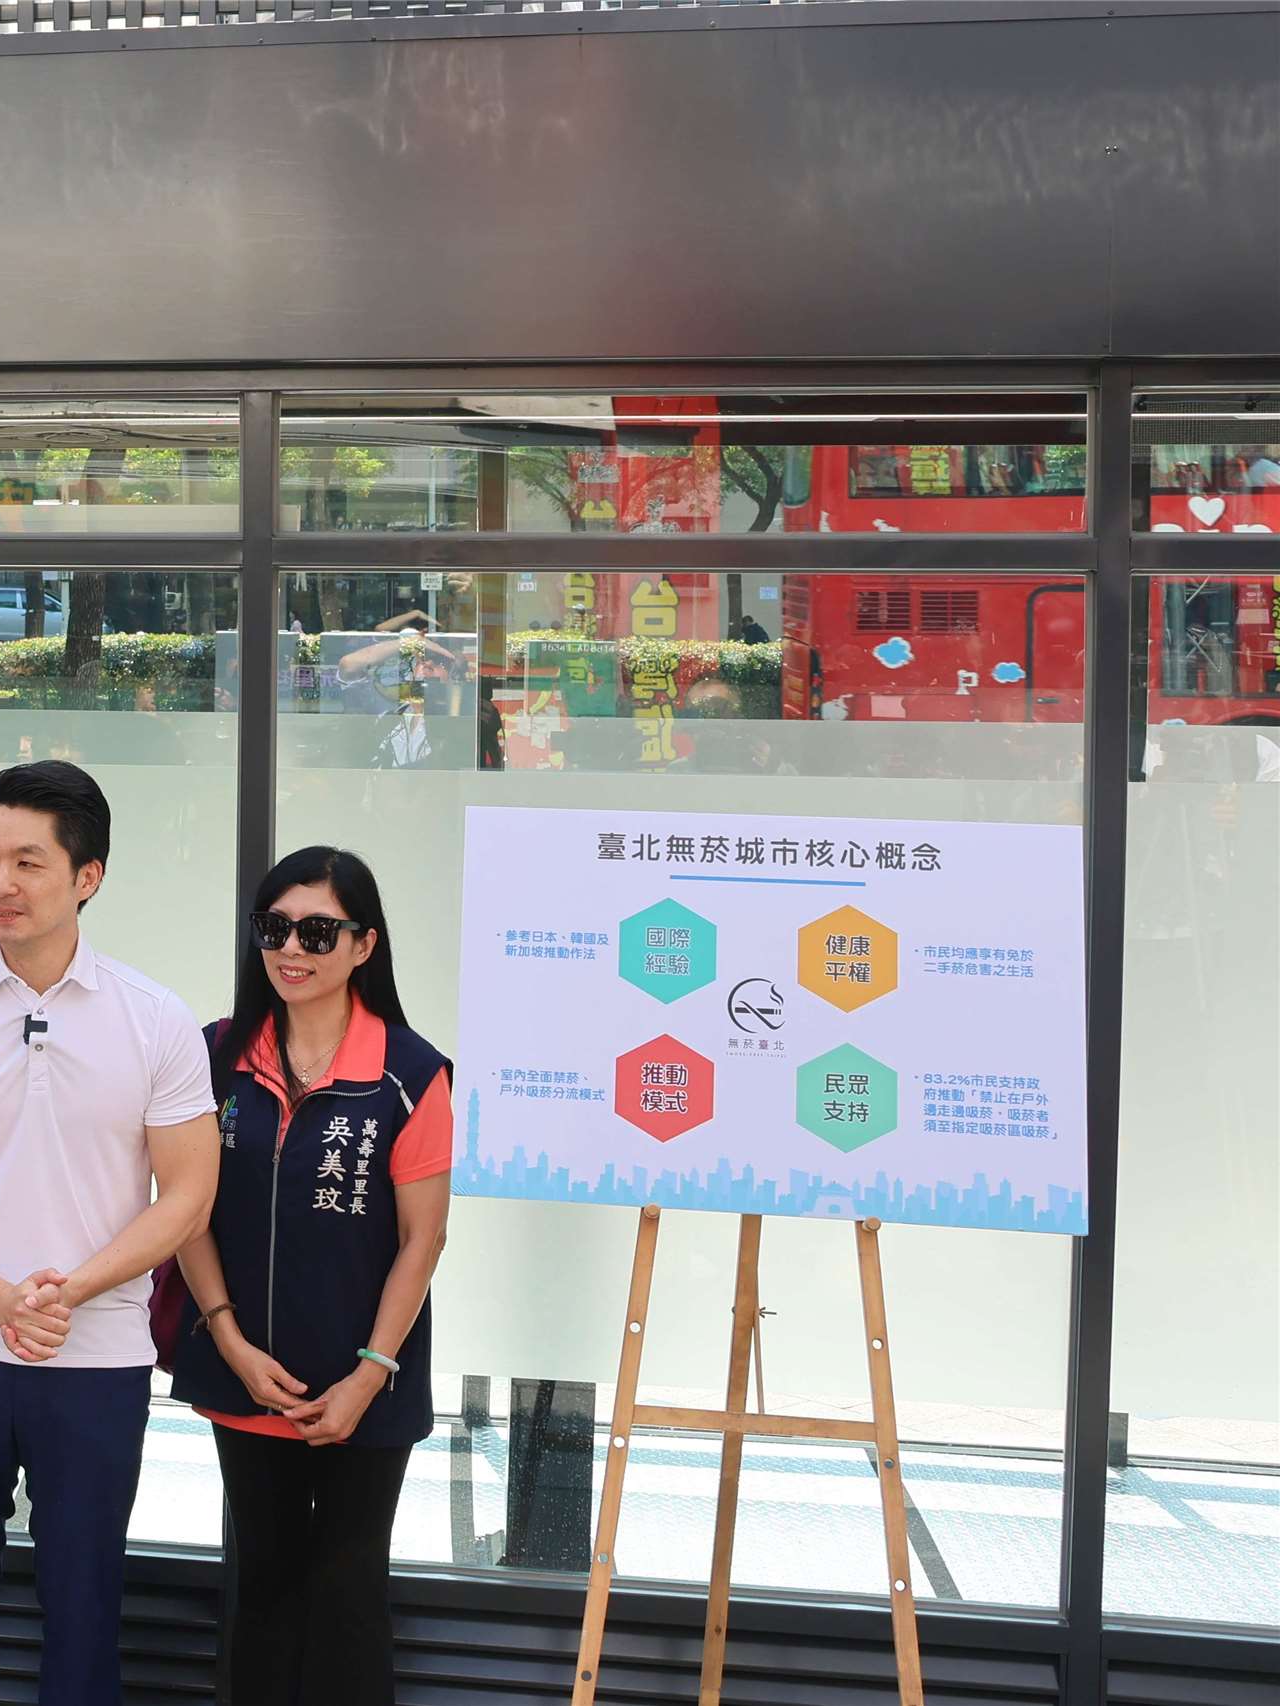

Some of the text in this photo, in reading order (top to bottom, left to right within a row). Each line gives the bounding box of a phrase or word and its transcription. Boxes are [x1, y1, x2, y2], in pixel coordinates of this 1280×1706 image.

[596, 832, 942, 871] 臺北無菸城市核心概念
[645, 927, 690, 949] 國際
[825, 934, 871, 956] 健康
[504, 944, 596, 960] 新加坡推動作法
[645, 953, 689, 976] 經驗
[825, 962, 871, 983] 平權
[642, 1062, 687, 1086] 推動
[824, 1073, 870, 1095] 民眾
[499, 1083, 606, 1101] 戶外吸菸分流模式
[641, 1090, 687, 1112] 模式
[823, 1100, 870, 1123] 支持
[312, 1116, 354, 1213] 吳美玟
[349, 1118, 378, 1215] 萬壽里里長
